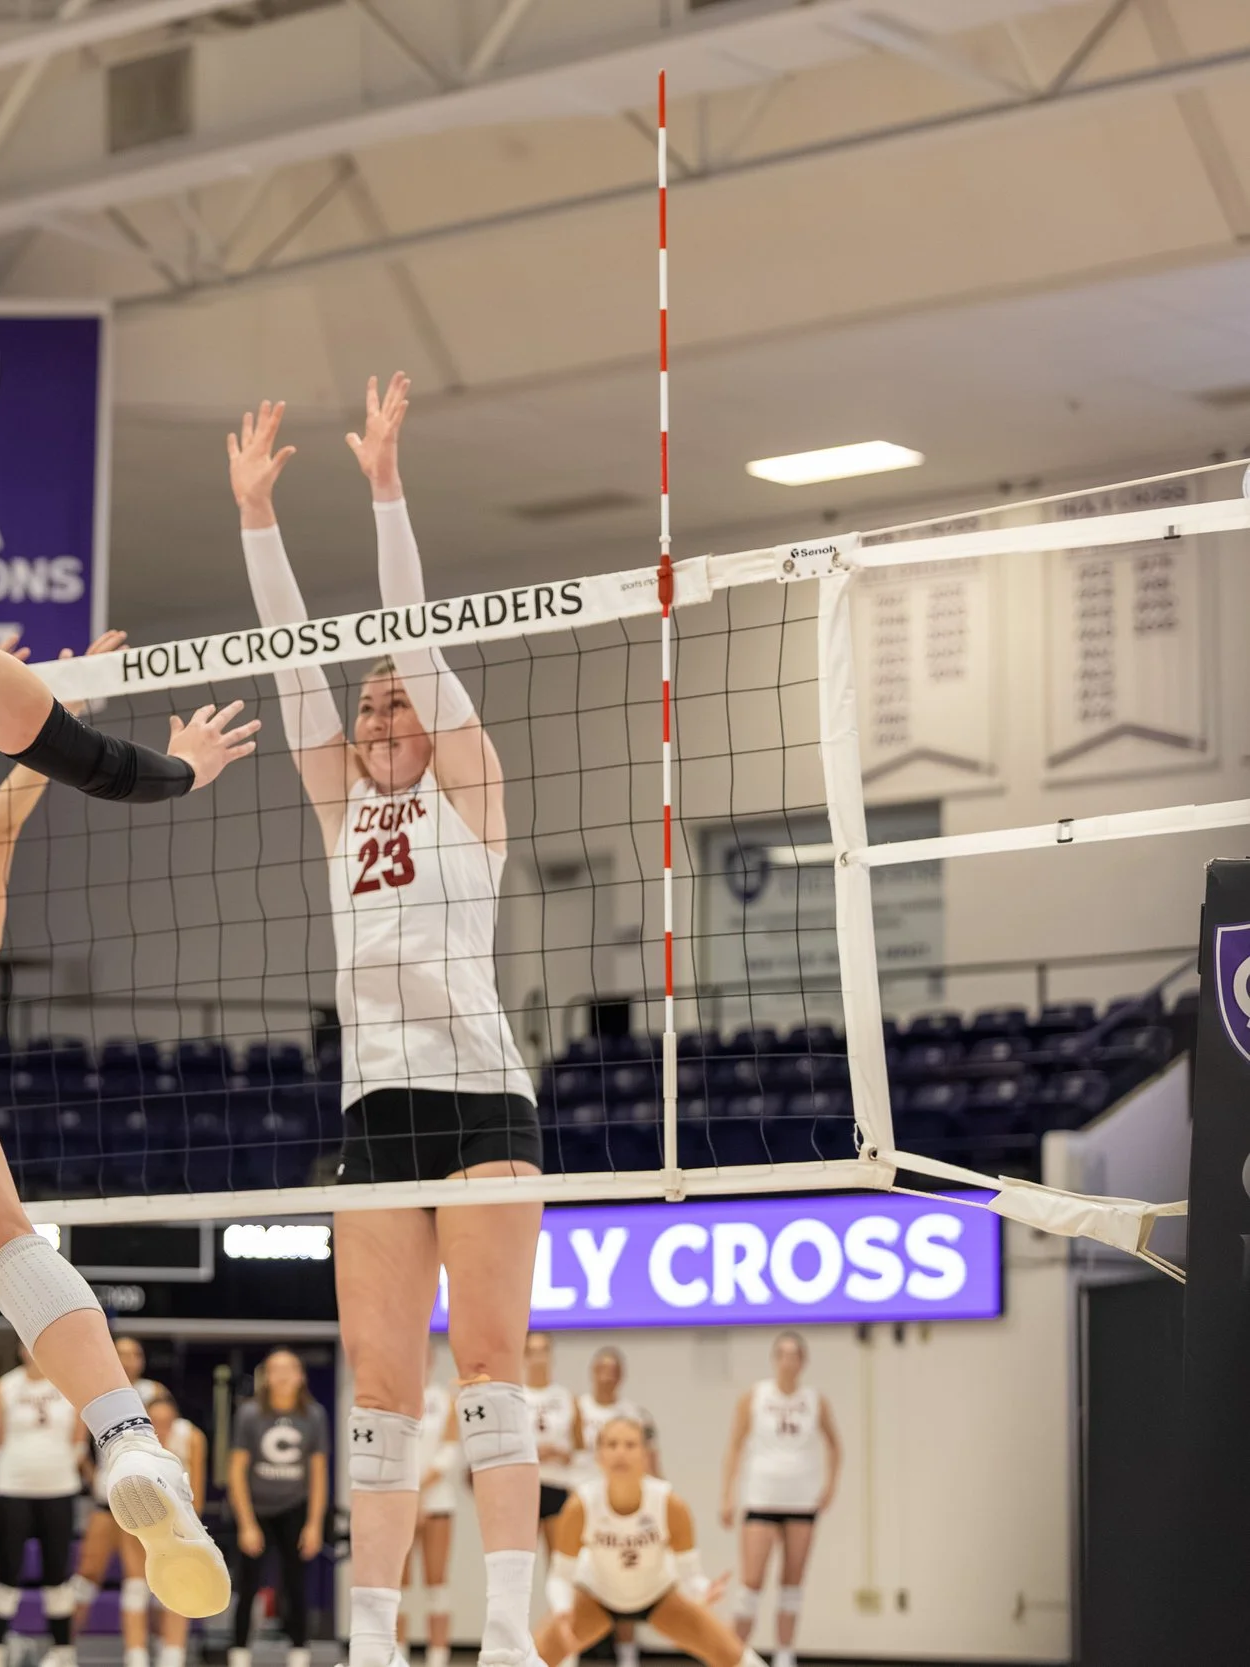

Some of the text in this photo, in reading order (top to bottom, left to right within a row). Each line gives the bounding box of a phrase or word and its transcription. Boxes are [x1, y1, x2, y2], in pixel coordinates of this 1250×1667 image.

[800, 545, 837, 558] Senoh
[122, 582, 583, 682] HOLY CROSS CRUSADERS
[352, 832, 415, 895] 23
[529, 1212, 968, 1310] LY CROSS
[261, 1425, 303, 1464] C
